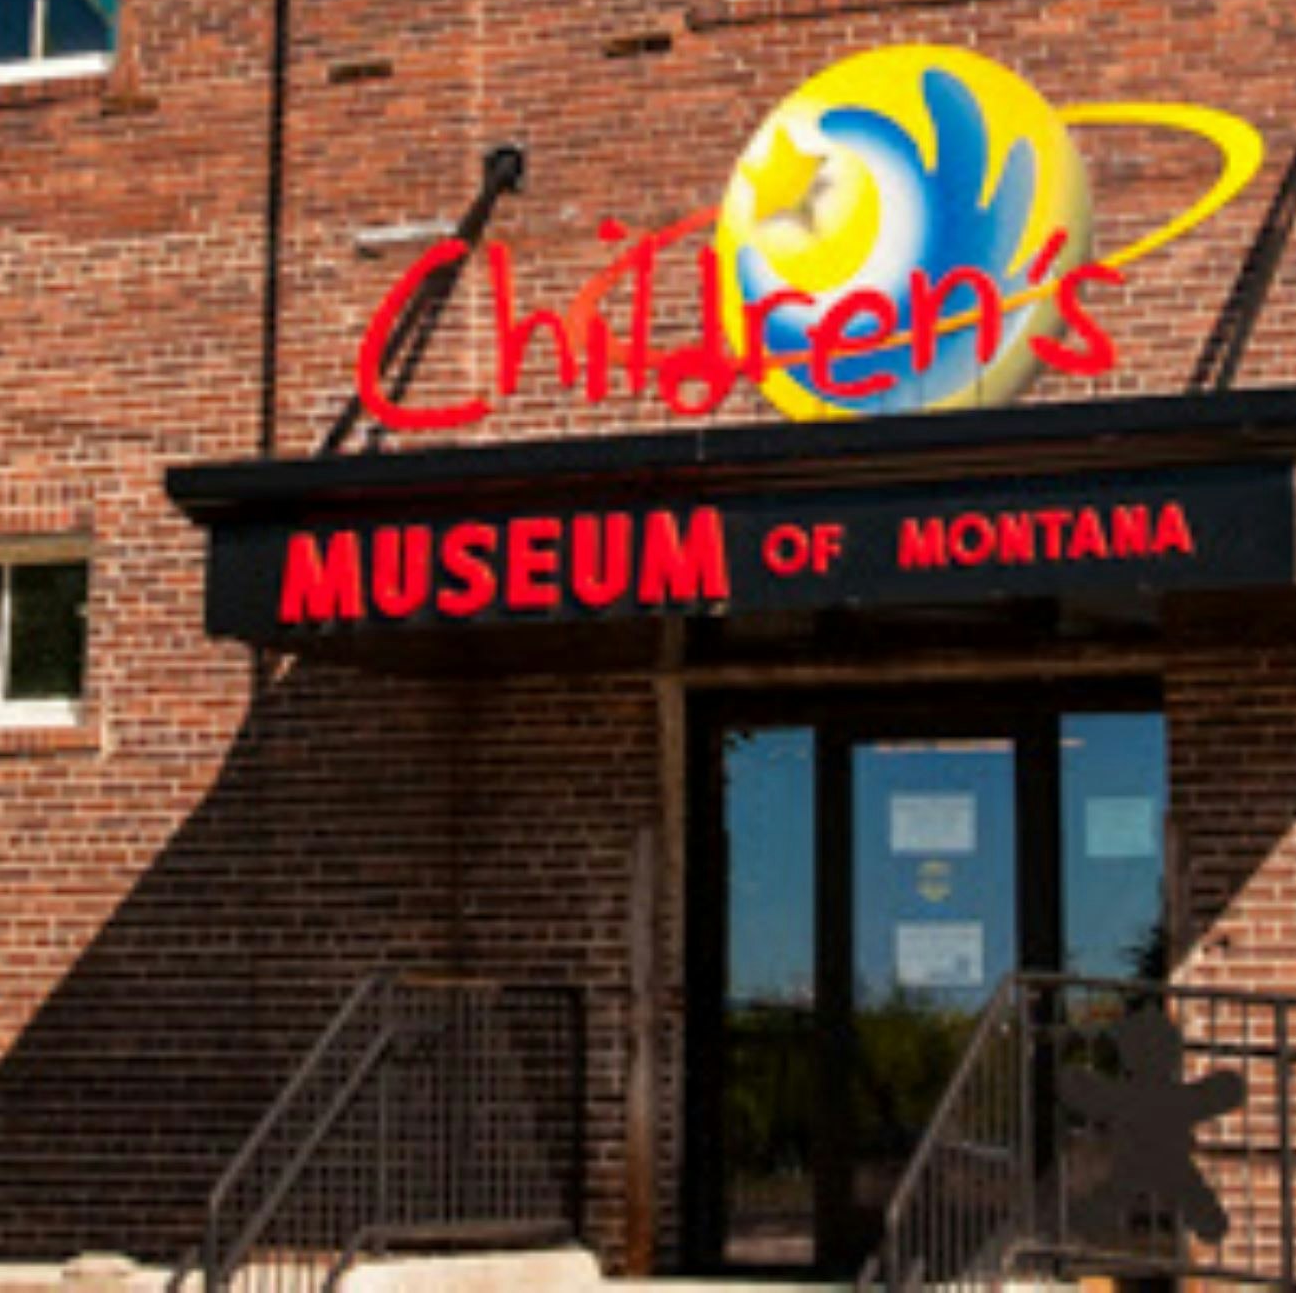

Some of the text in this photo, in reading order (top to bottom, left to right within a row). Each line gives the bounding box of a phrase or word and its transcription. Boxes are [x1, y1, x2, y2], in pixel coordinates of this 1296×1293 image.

[355, 219, 1126, 431] Children's
[278, 503, 1194, 624] MUSEUM OF MONTANA
